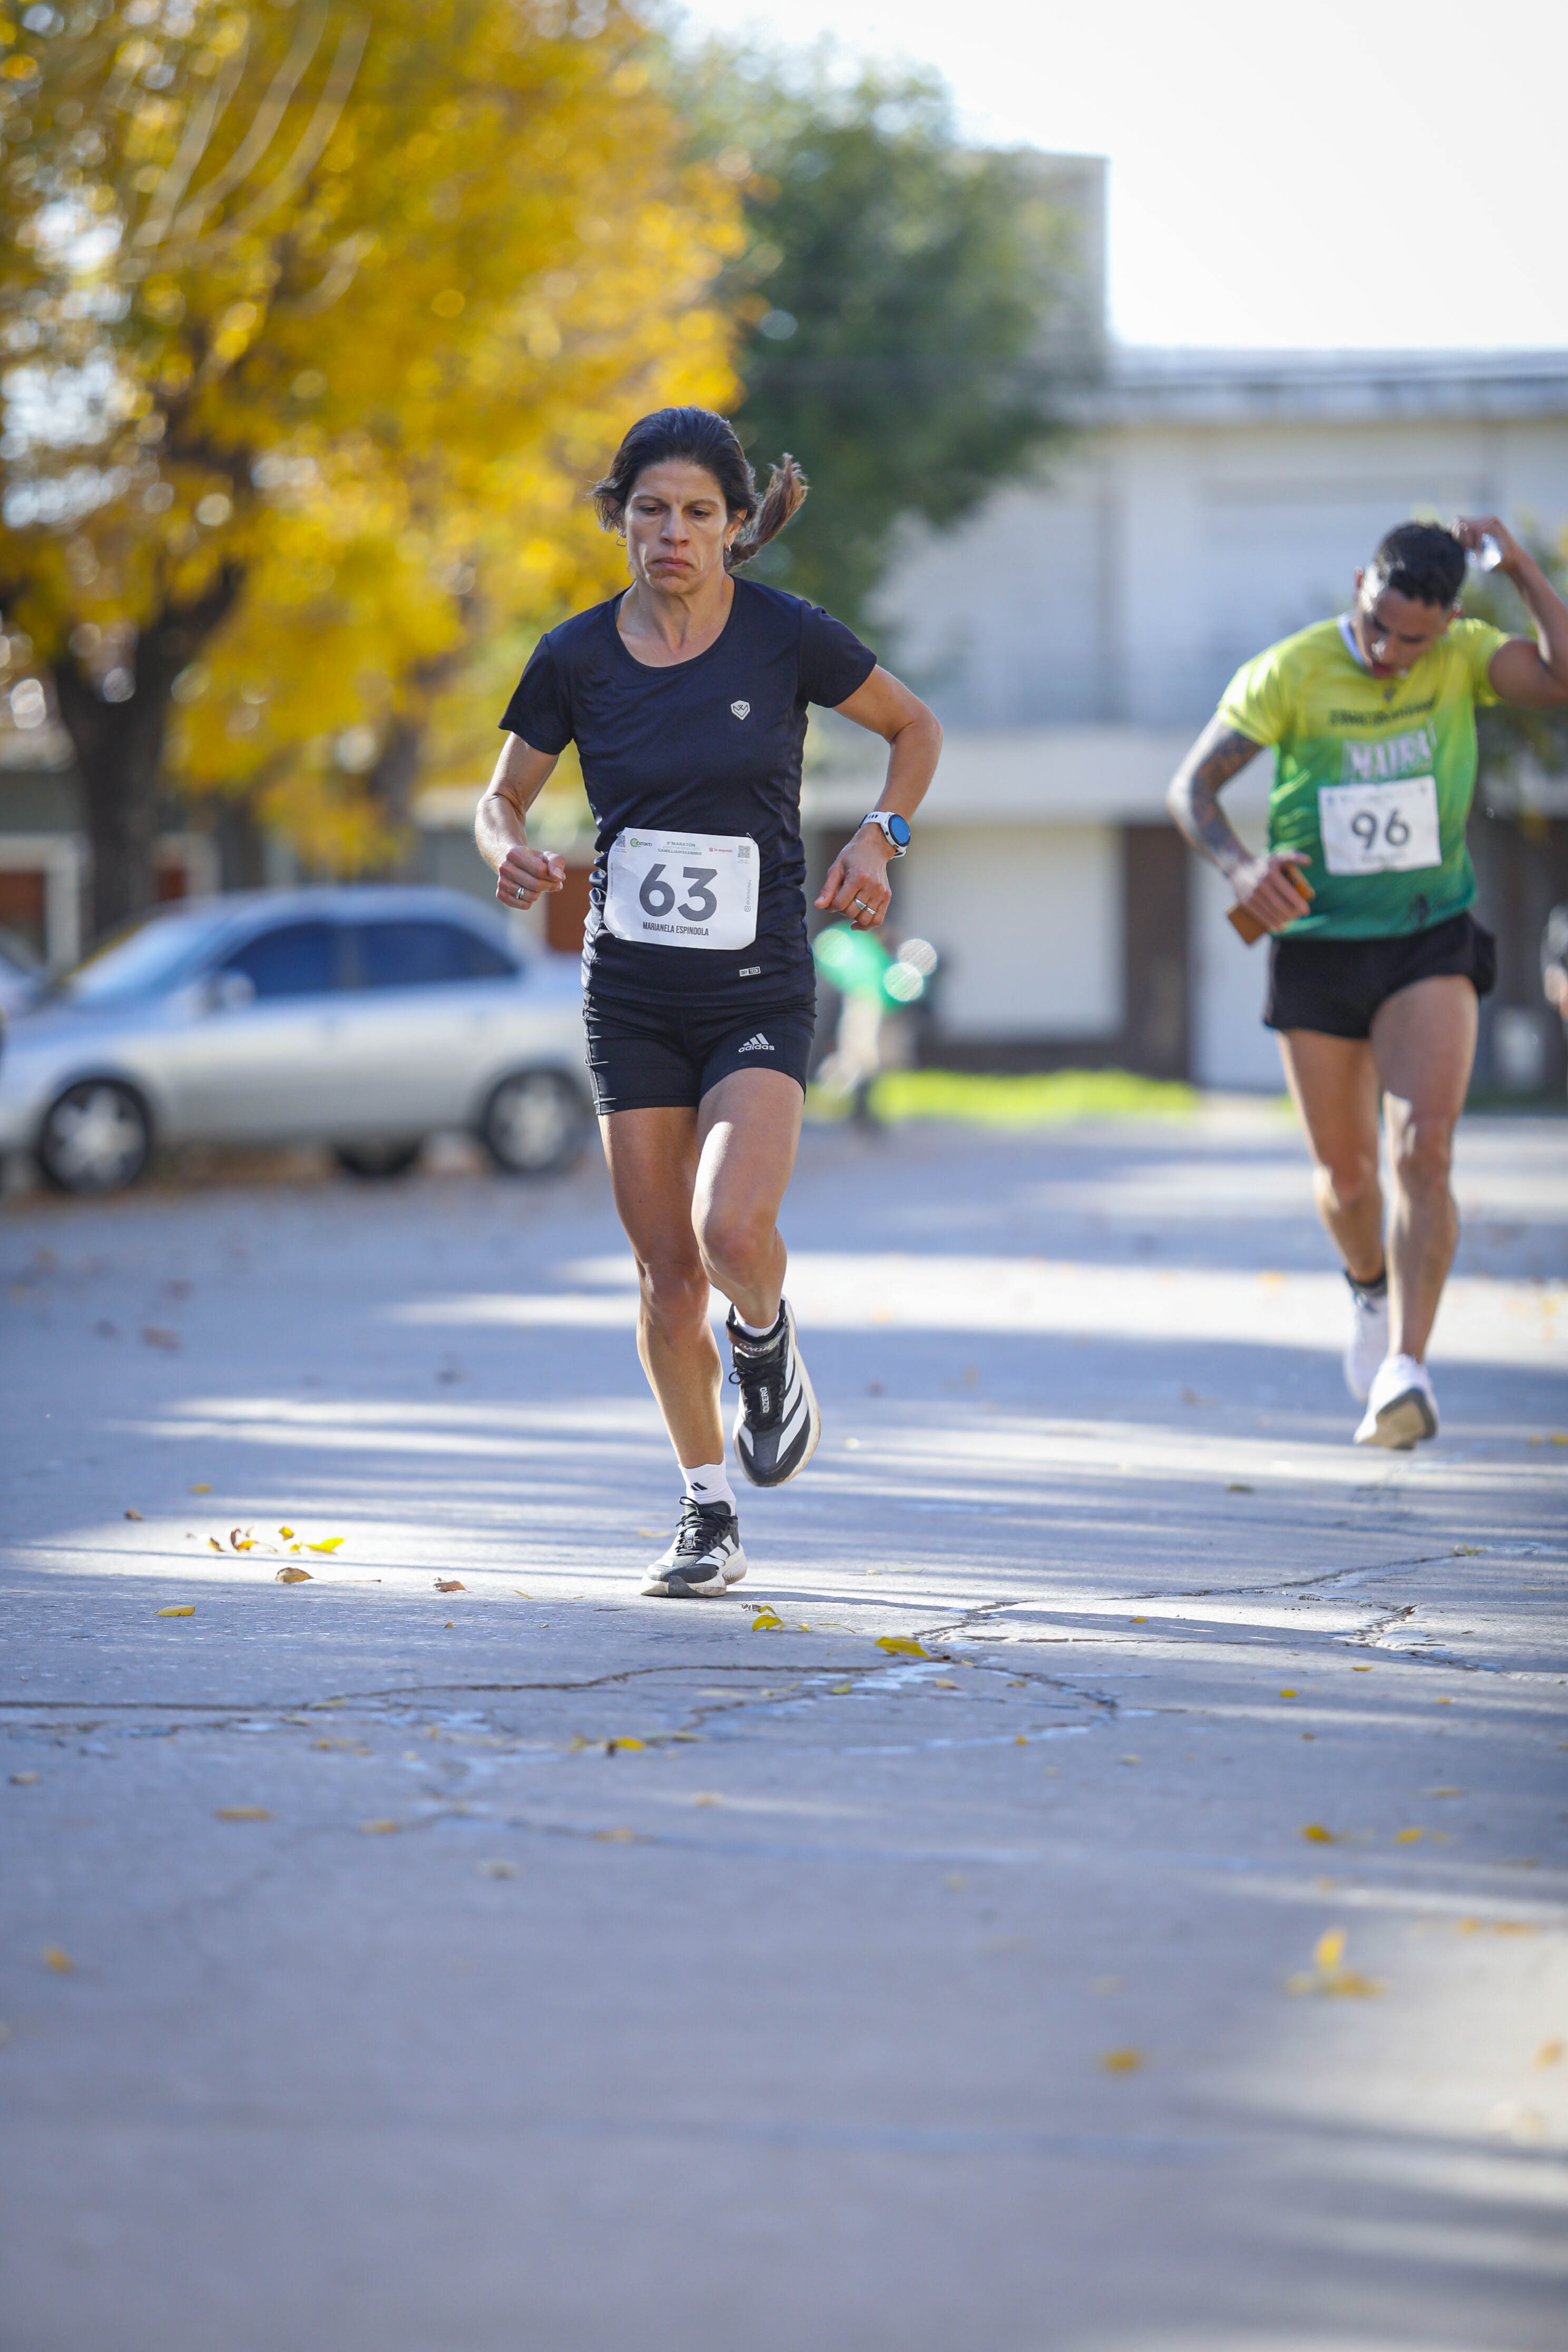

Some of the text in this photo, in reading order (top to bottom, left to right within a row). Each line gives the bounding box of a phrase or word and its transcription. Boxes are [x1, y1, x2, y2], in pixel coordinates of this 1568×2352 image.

[1351, 808, 1410, 850] 96
[639, 863, 718, 922] 63
[643, 921, 709, 936] MARIANELA ESPINDOLA
[738, 1043, 775, 1053] adidas
